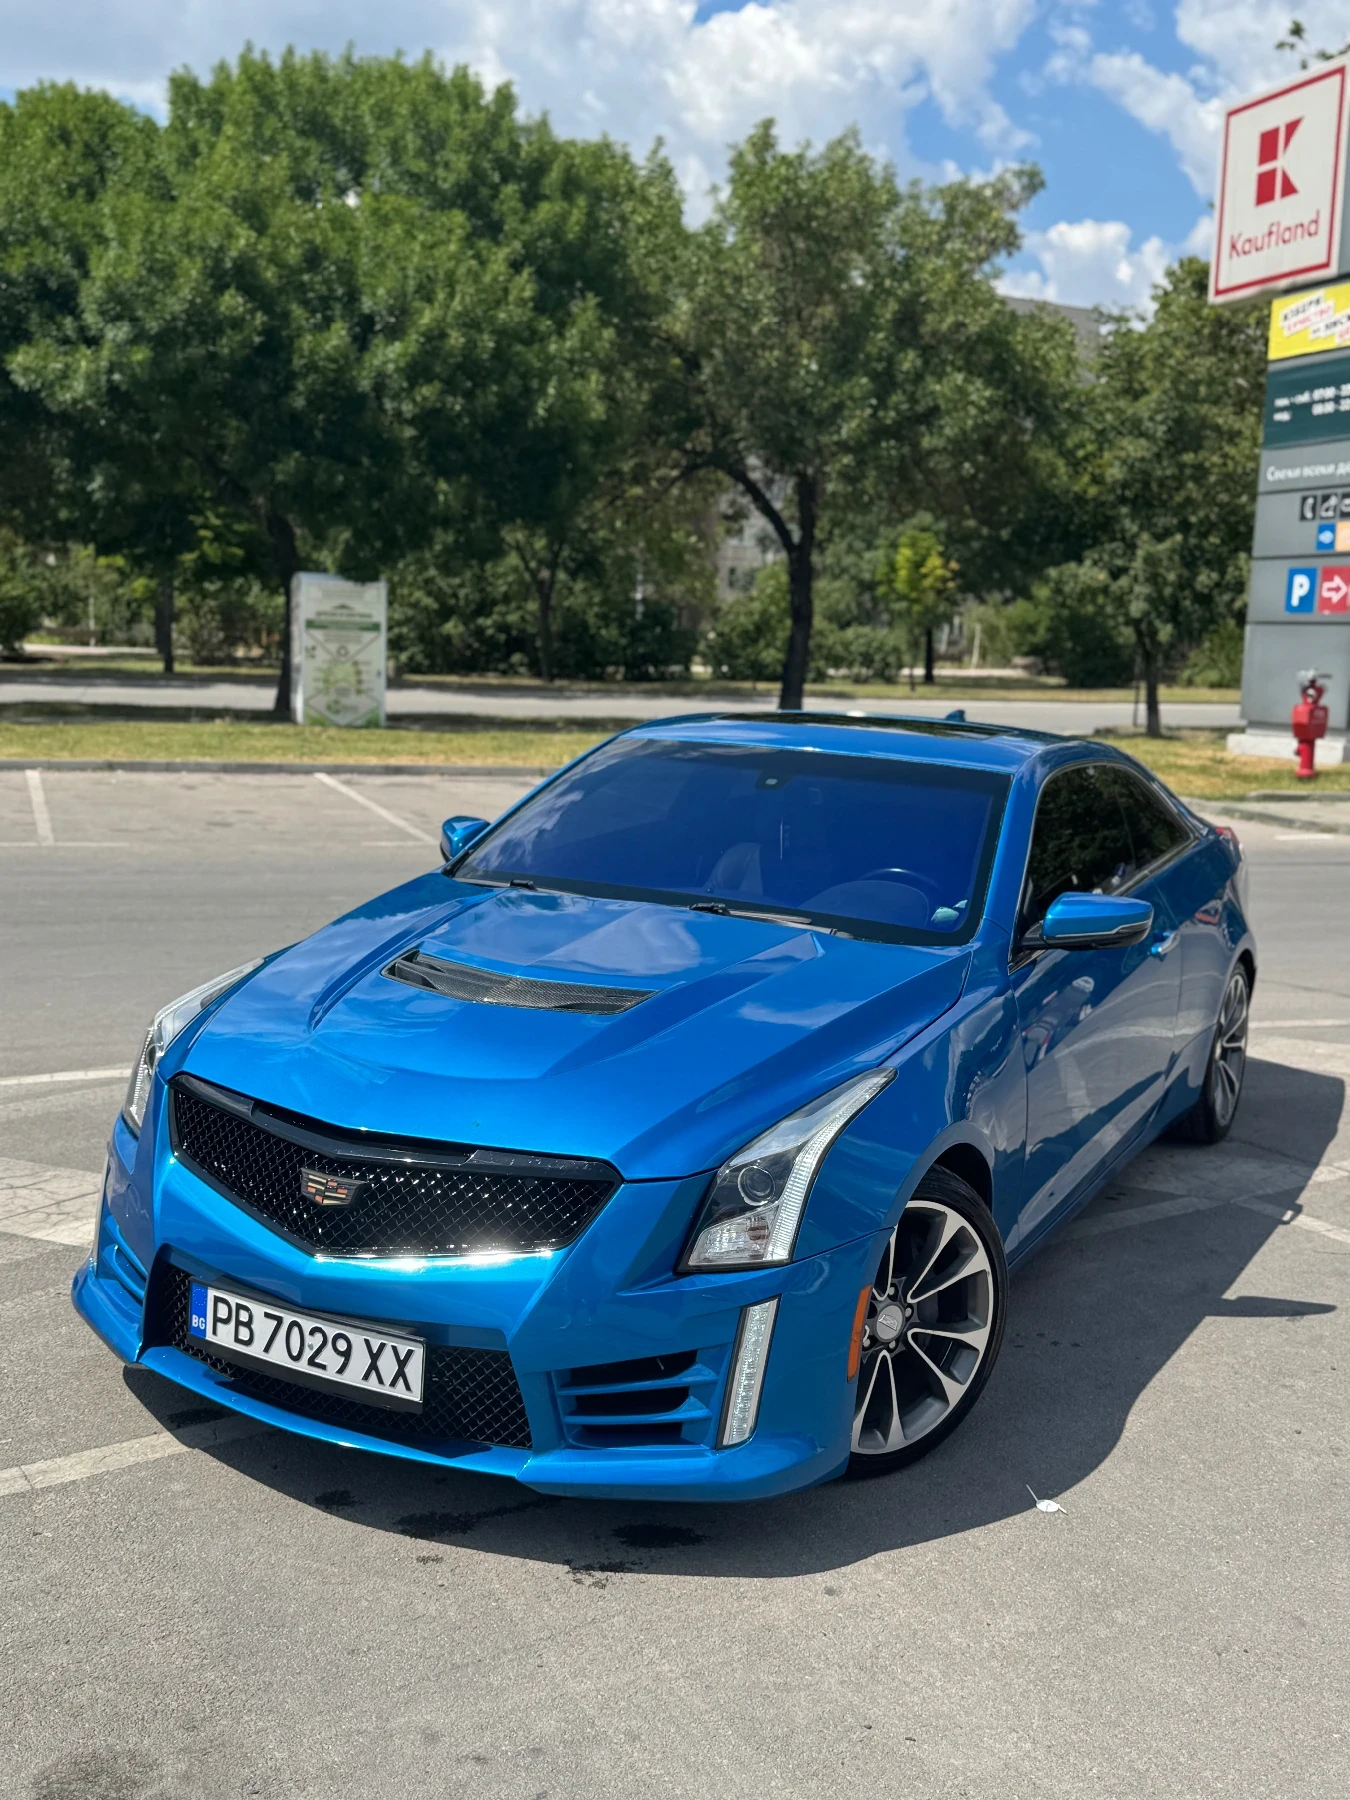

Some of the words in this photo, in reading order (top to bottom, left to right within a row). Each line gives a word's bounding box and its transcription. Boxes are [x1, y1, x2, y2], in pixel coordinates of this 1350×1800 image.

[1228, 208, 1321, 259] Kaufland
[1290, 573, 1311, 607] P
[192, 1314, 206, 1331] BG
[212, 1294, 254, 1347] PB
[263, 1311, 353, 1375] 7029
[361, 1337, 415, 1393] XX
